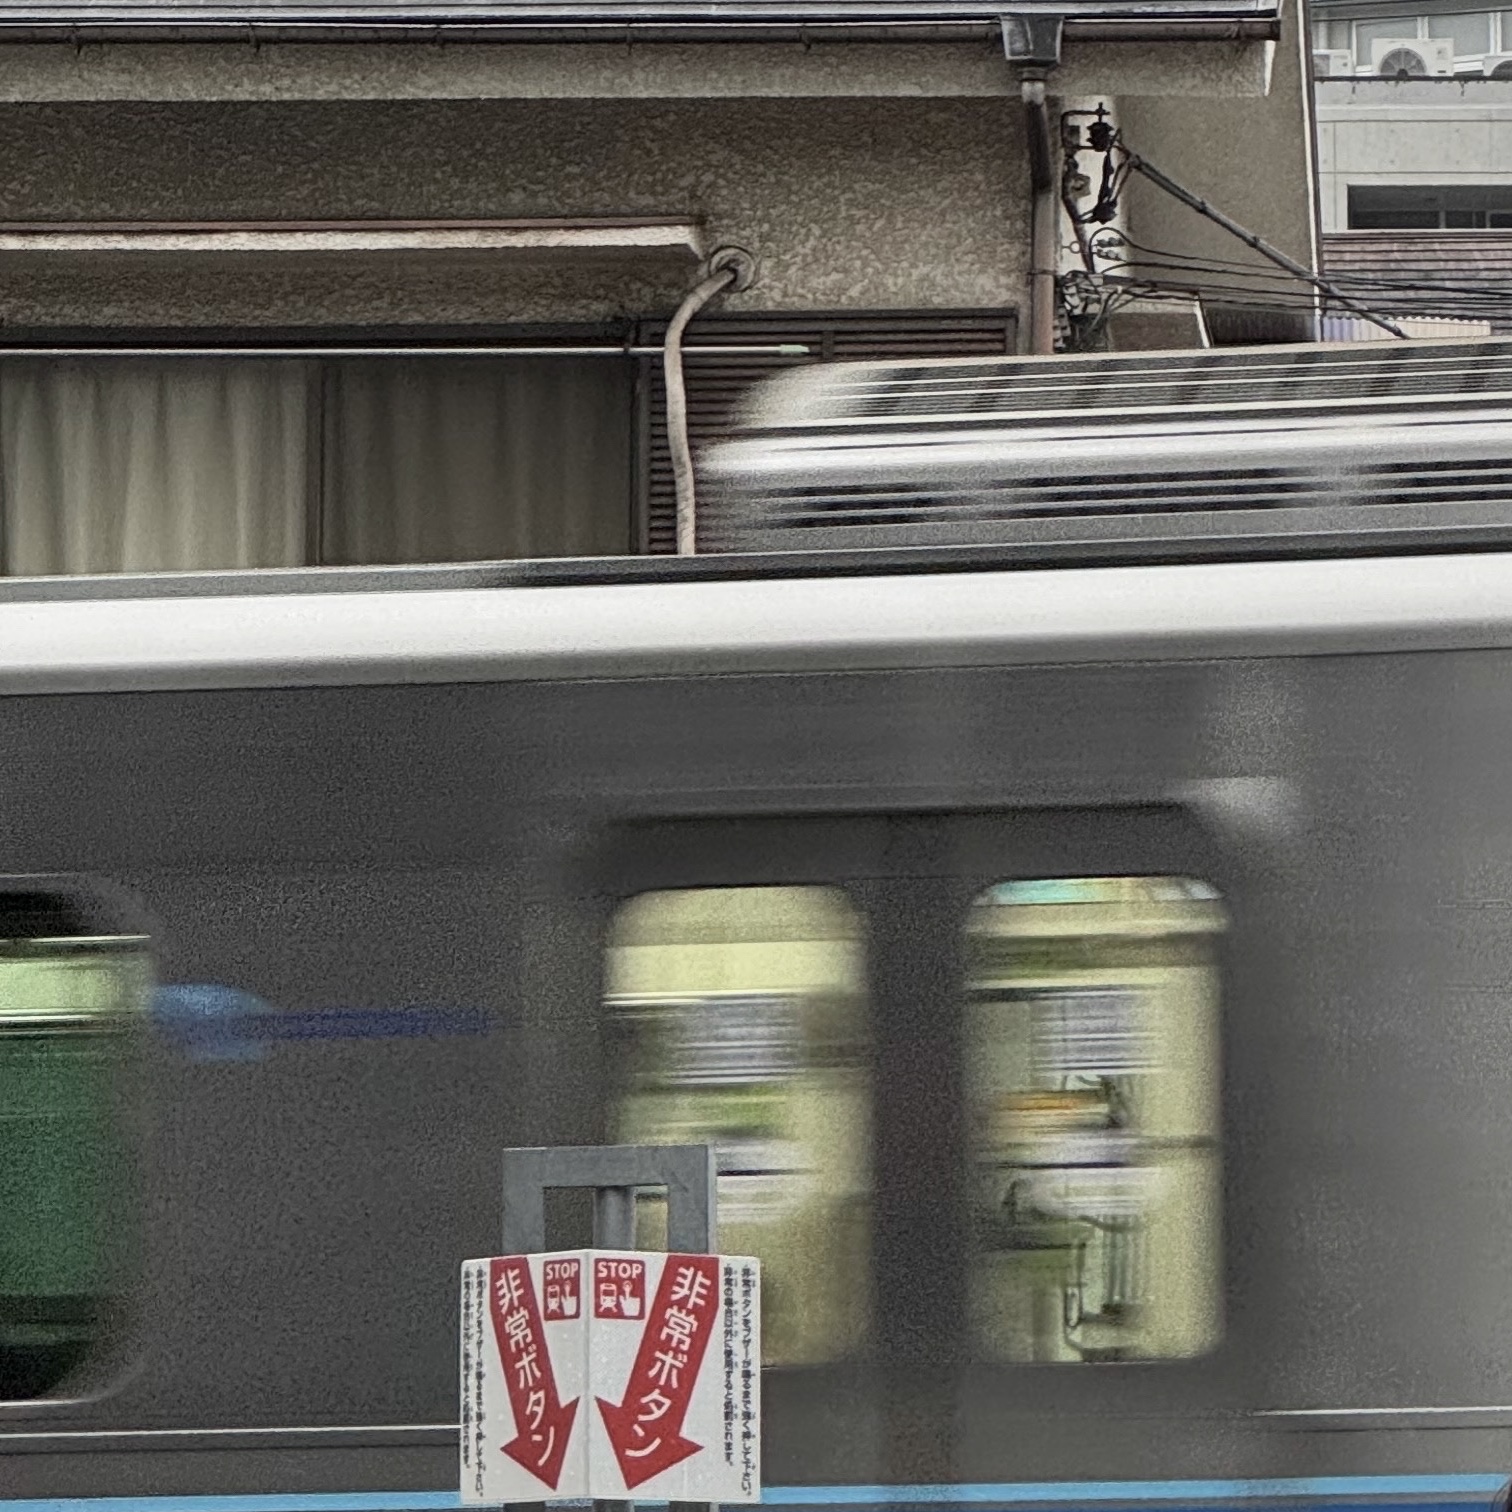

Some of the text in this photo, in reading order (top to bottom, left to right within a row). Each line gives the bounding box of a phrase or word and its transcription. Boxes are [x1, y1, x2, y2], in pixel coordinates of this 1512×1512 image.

[546, 1262, 579, 1280] STOP
[597, 1261, 643, 1279] STOP
[494, 1267, 556, 1467] 非常ボタン
[624, 1265, 712, 1458] 非常ボタン
